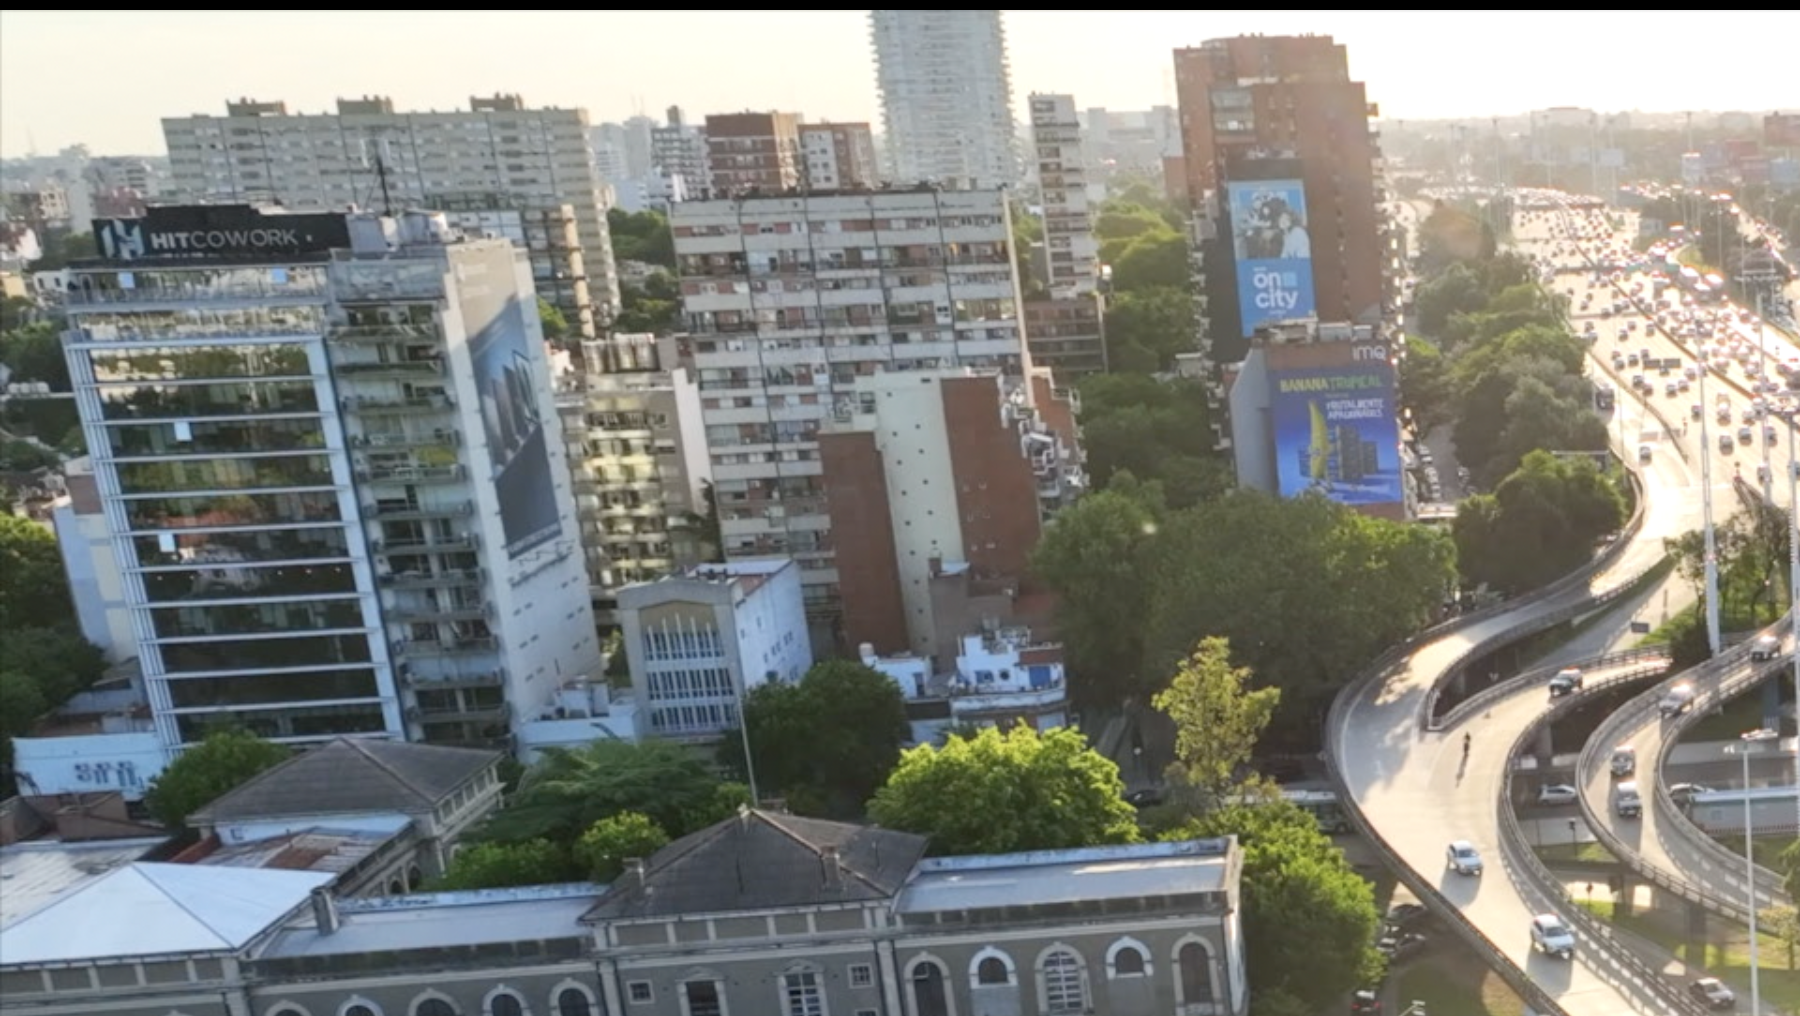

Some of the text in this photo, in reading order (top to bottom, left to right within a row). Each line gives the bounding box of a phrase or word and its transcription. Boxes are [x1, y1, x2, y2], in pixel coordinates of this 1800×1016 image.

[151, 229, 298, 249] HITCOWORK
[1253, 272, 1281, 289] on
[1255, 289, 1298, 309] city
